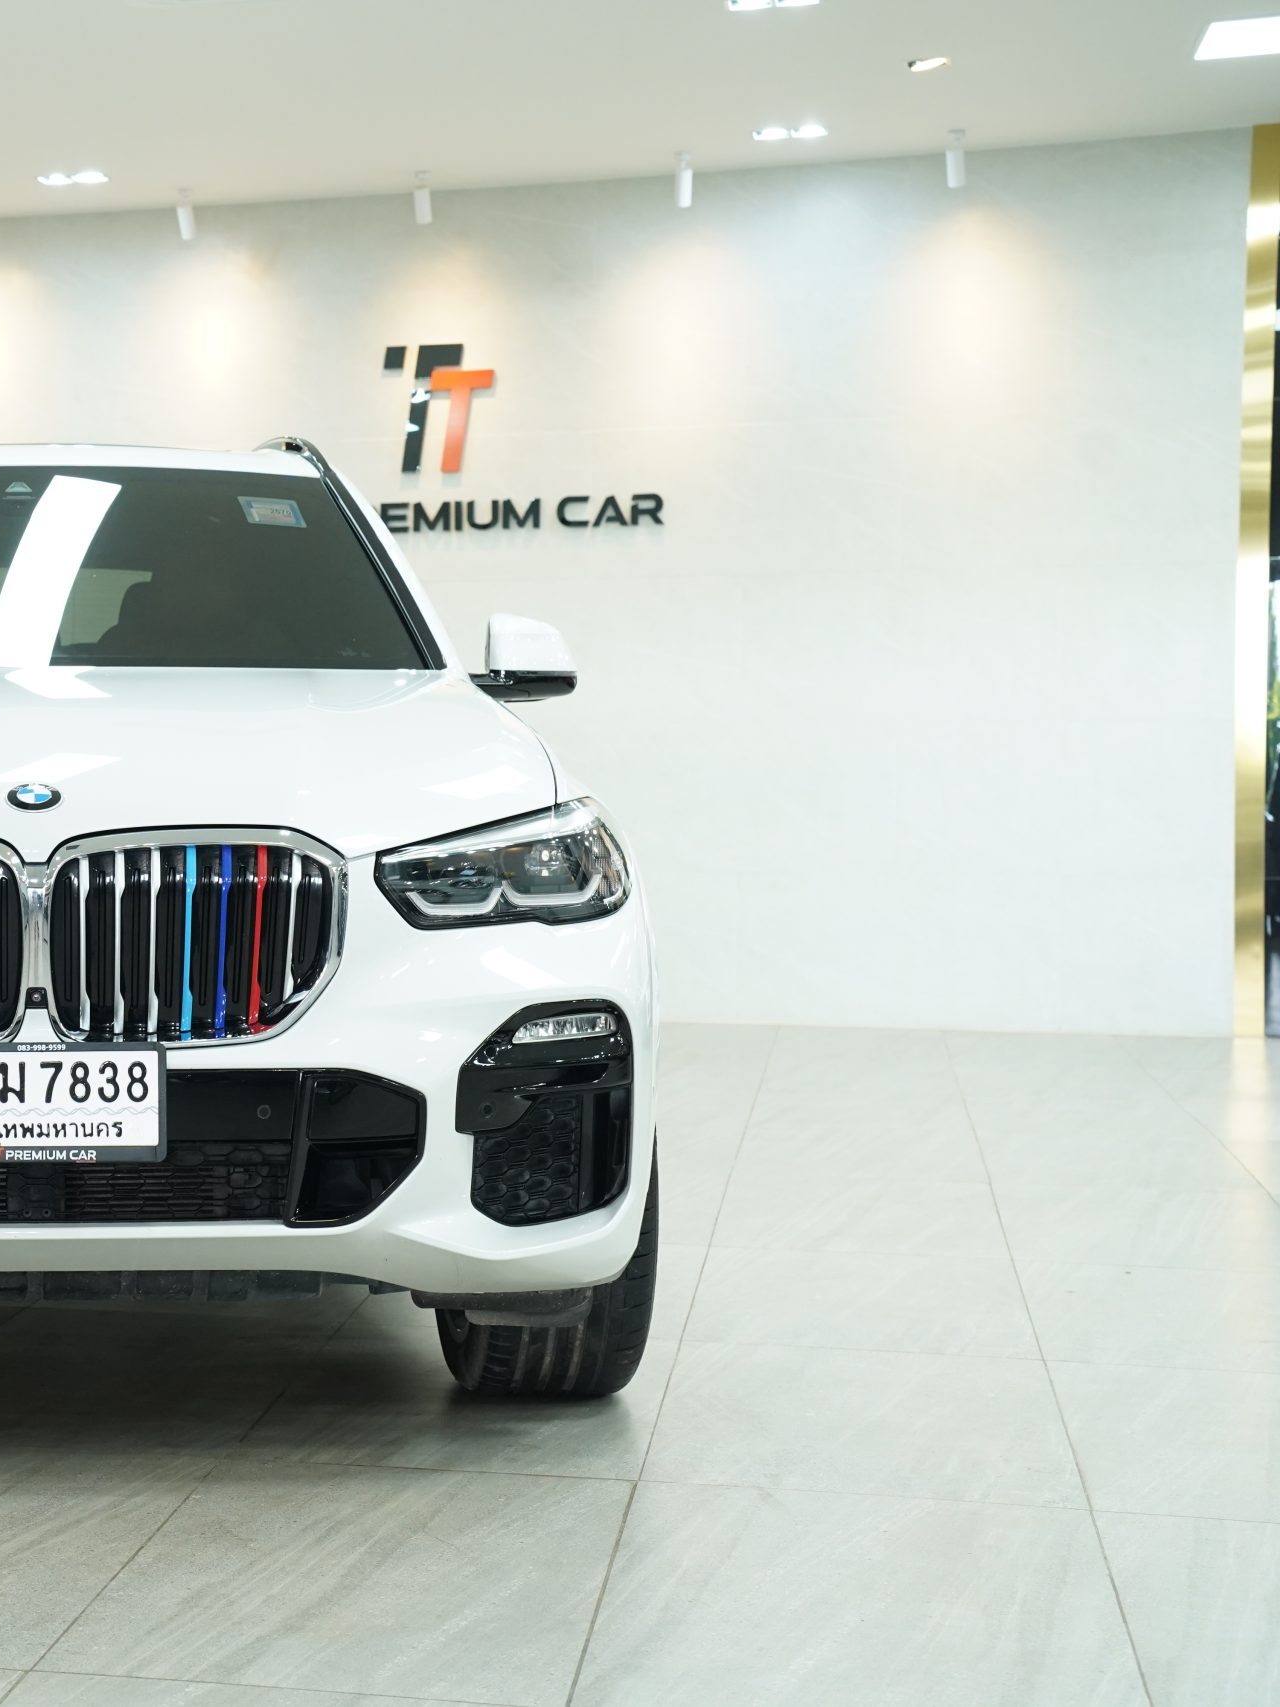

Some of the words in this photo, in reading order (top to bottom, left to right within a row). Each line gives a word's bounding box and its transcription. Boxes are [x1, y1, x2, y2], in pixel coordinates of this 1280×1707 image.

[372, 498, 541, 533] EMIUM
[556, 493, 665, 528] CAR
[16, 1043, 67, 1052] 083-998-9599
[40, 1060, 149, 1104] 7838
[5, 1149, 67, 1161] PREMIUM
[69, 1149, 97, 1161] CAR
